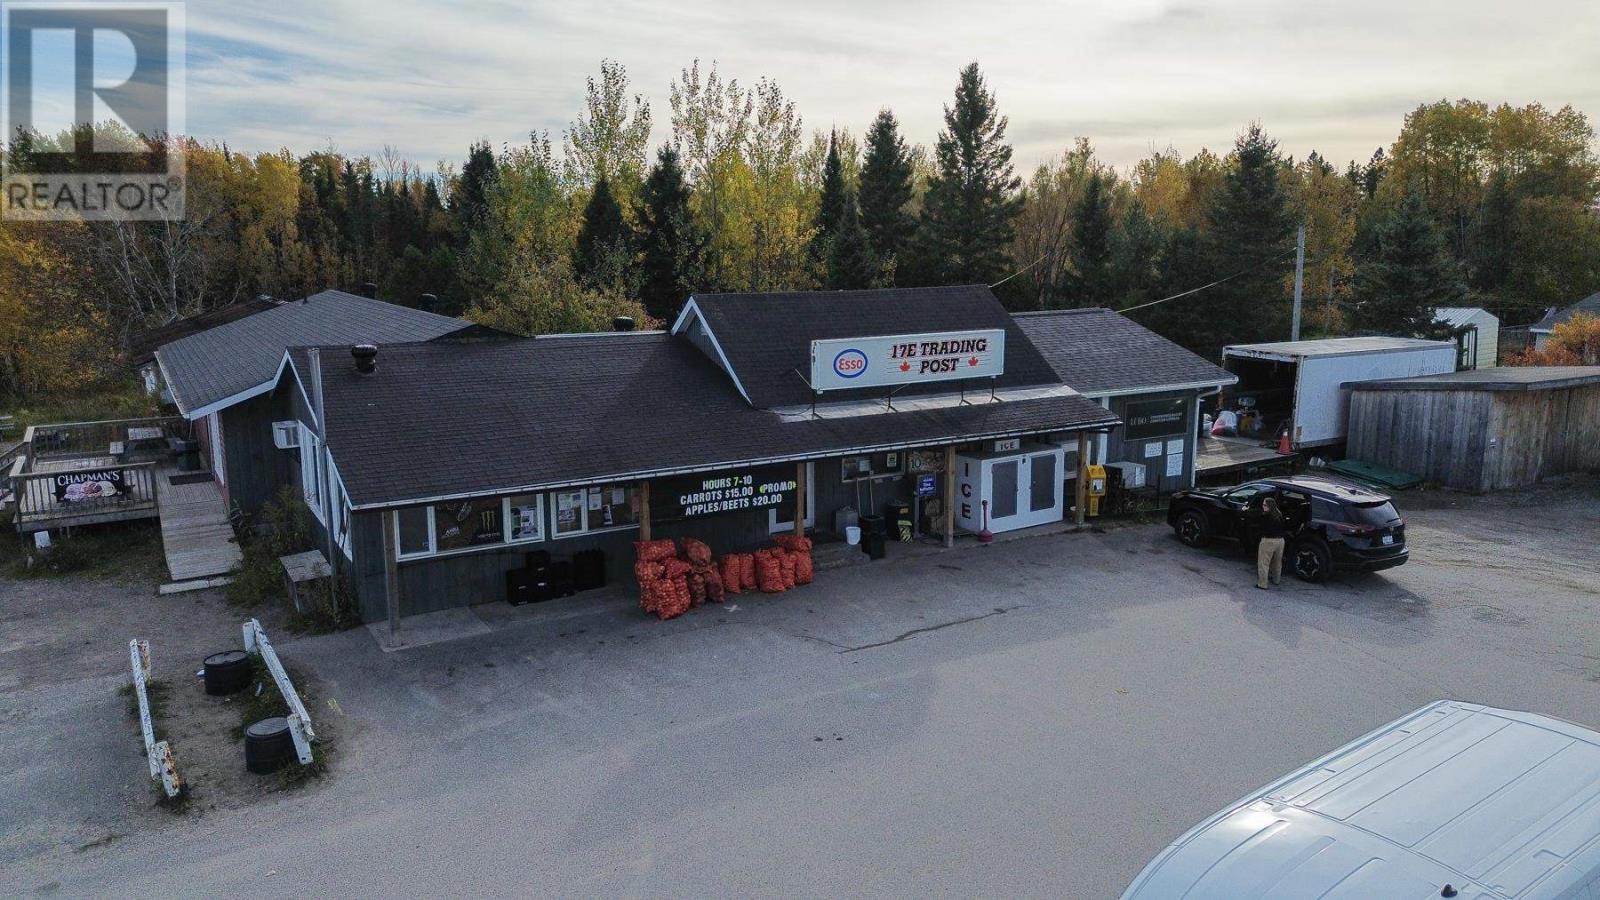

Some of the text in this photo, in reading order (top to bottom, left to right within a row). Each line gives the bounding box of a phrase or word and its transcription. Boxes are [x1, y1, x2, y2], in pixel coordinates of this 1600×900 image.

[891, 338, 987, 359] 17E TRADING
[919, 358, 959, 374] POST
[1000, 440, 1016, 449] ICE
[57, 470, 120, 486] CHAPMAN'S
[702, 475, 753, 491] HOURS 7-10
[680, 490, 723, 506] CARROTS
[725, 486, 754, 499] $15.00
[961, 462, 972, 520] ICE
[685, 493, 783, 516] APPLES/BEETS $20.00
